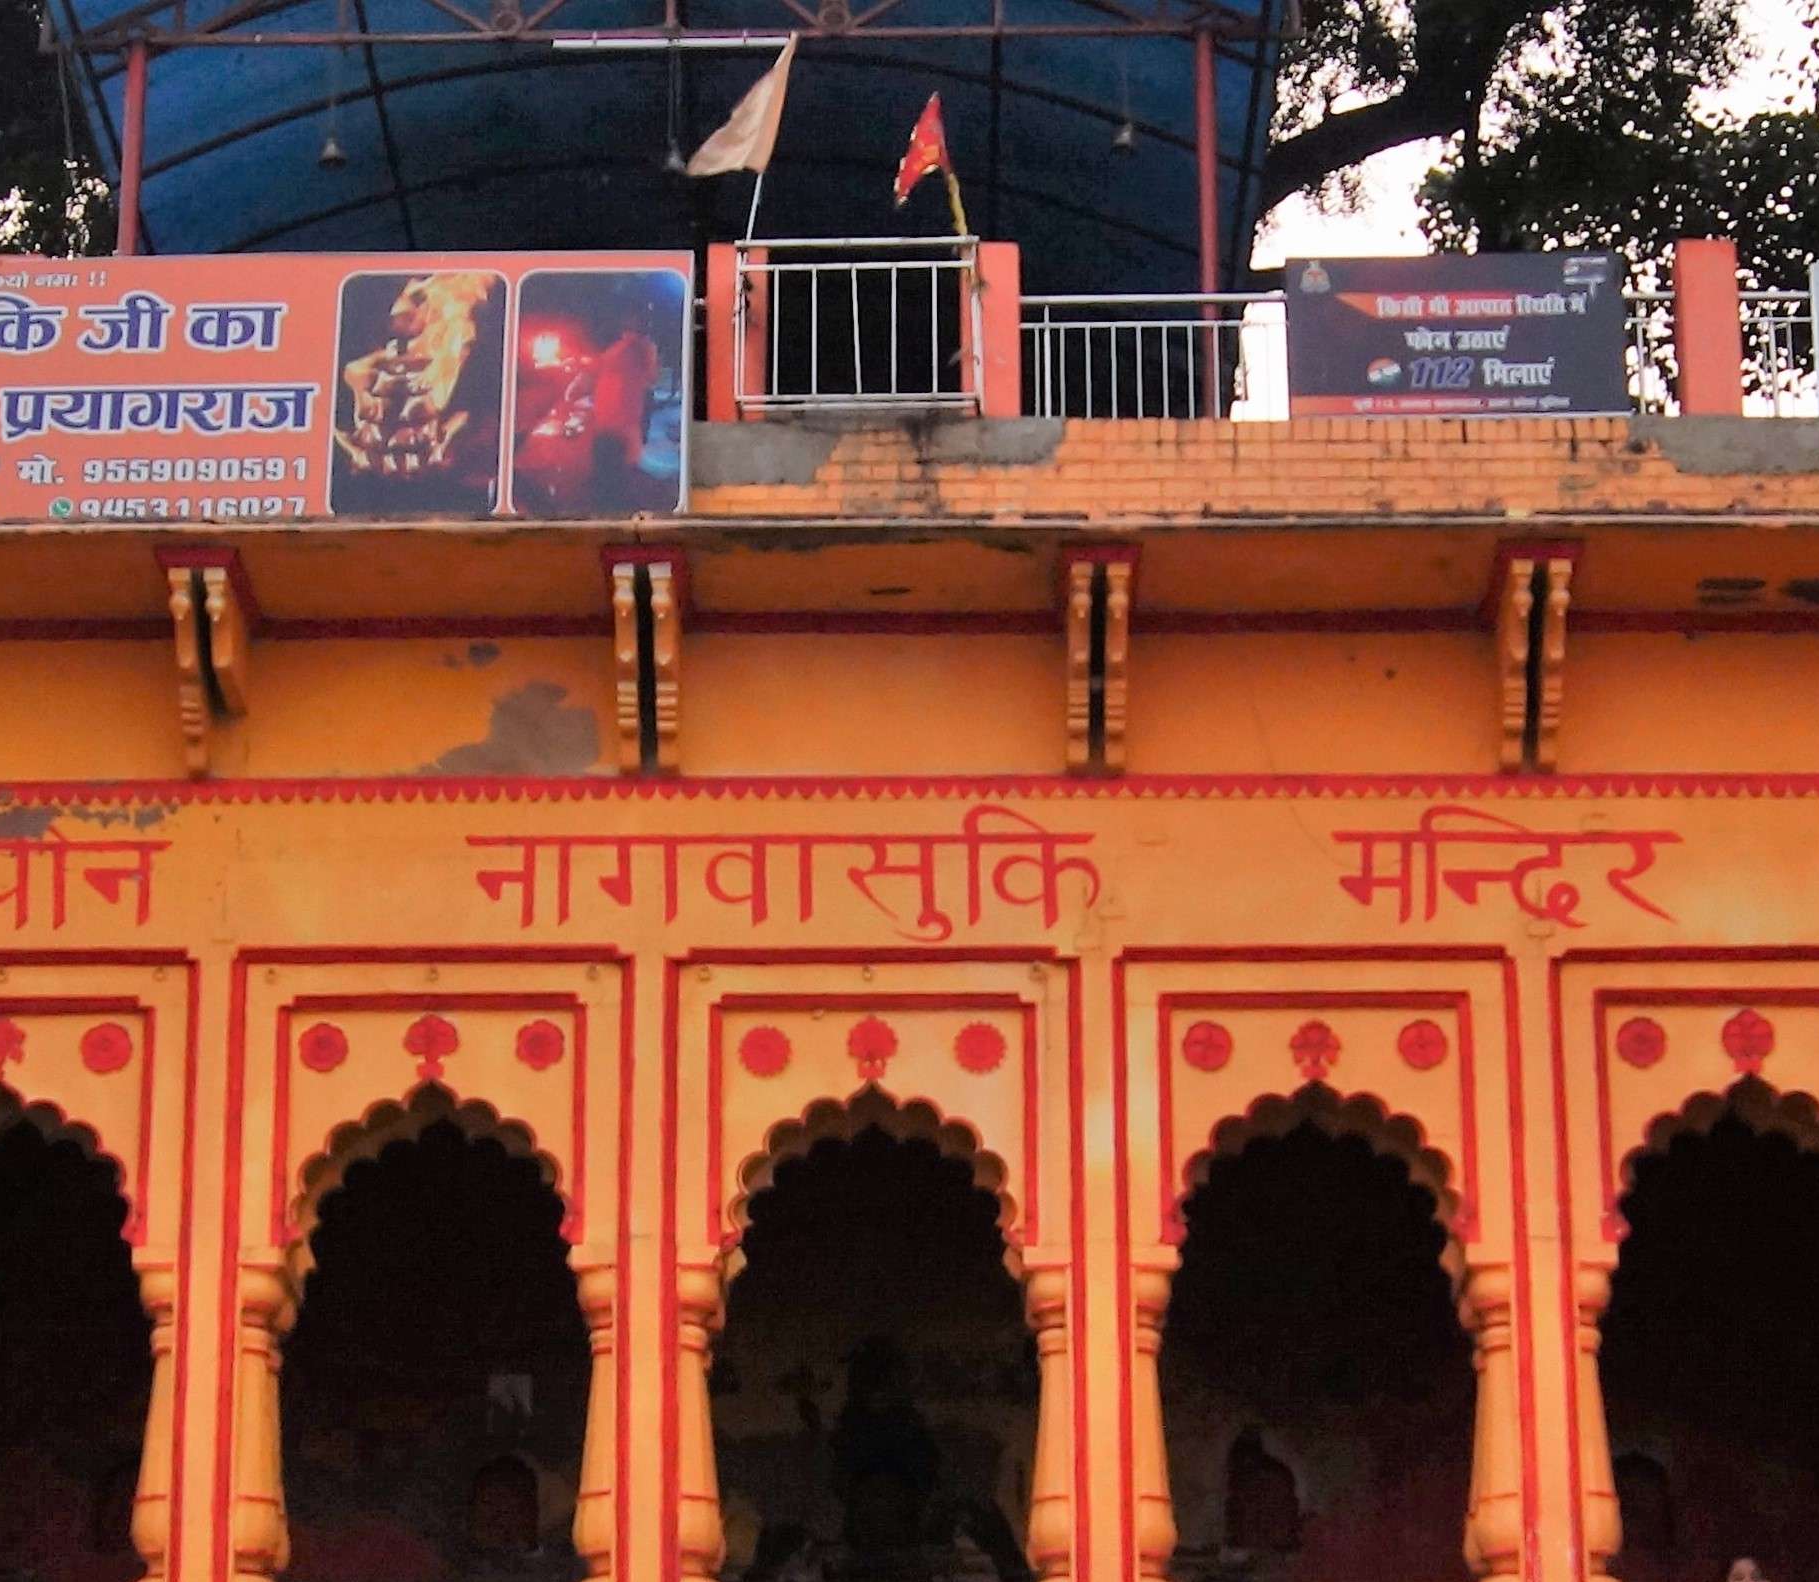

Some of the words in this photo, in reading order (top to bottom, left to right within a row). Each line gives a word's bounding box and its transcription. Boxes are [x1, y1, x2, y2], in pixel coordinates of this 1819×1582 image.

[81, 293, 172, 351] जी
[186, 303, 285, 349] का
[1409, 355, 1475, 388] 112
[0, 386, 316, 437] प्रयागराज
[15, 454, 64, 485] मो.
[82, 456, 308, 484] 9559090591
[465, 804, 1101, 943] नागवासुकि
[1331, 804, 1684, 929] मन्दिर
